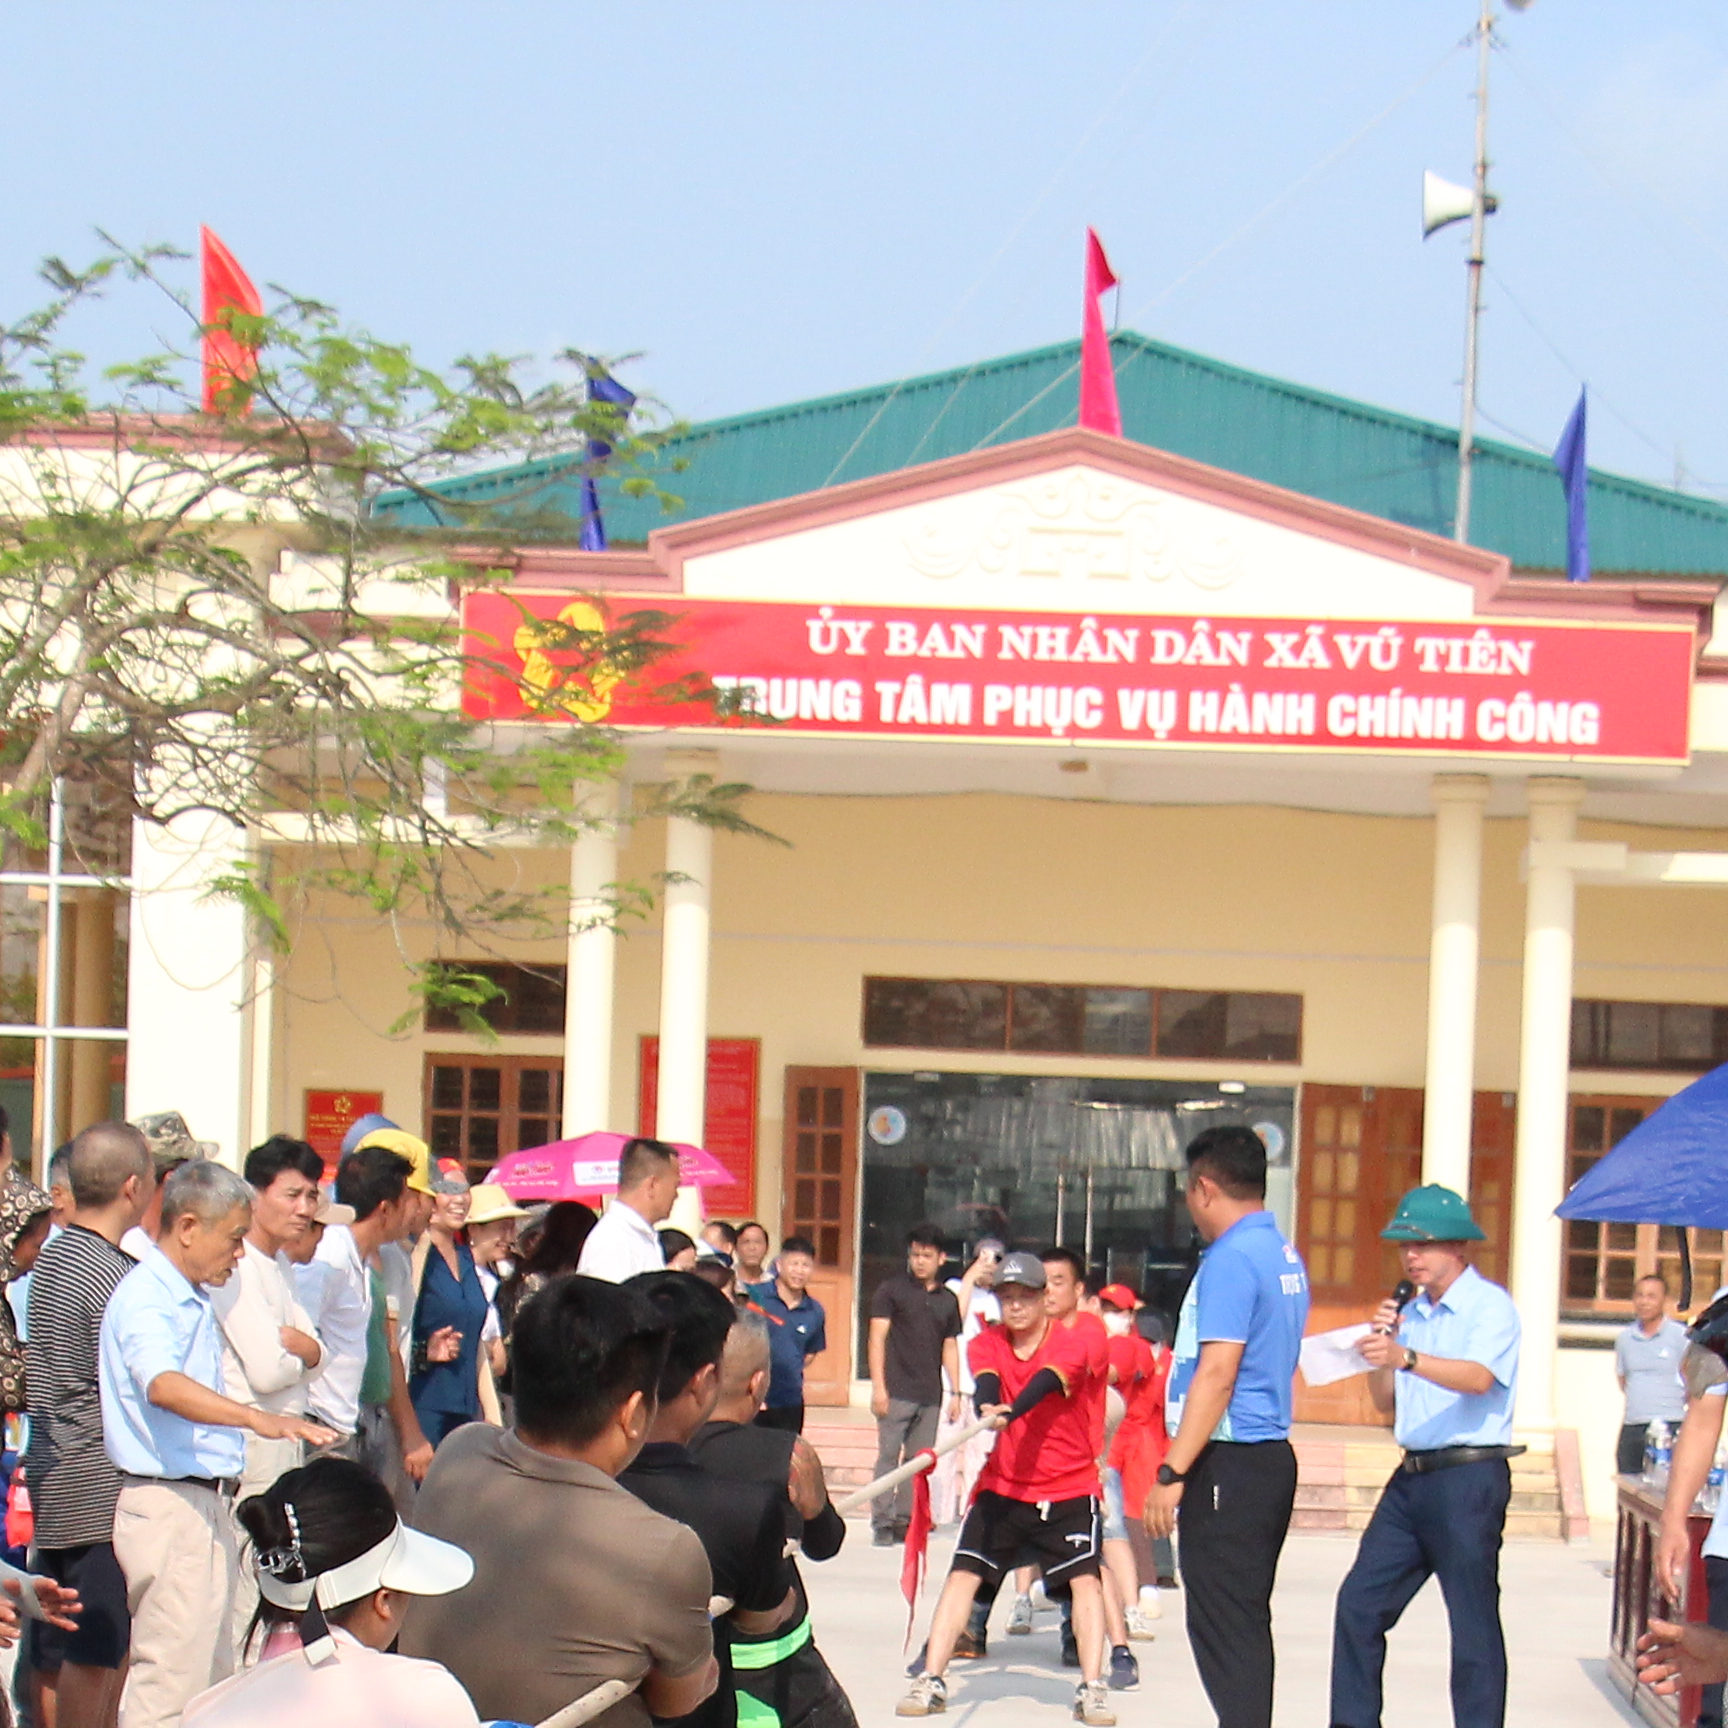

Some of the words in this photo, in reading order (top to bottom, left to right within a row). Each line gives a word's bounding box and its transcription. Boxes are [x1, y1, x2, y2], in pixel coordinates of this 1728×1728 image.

[805, 606, 874, 656] ỦY
[883, 619, 987, 660] BAN
[996, 616, 1141, 665] NHÂN
[1150, 619, 1252, 667] DÂN
[1262, 624, 1331, 669] XÃ
[1332, 625, 1404, 672] VŨ
[1413, 628, 1535, 676] TIÊN
[874, 673, 972, 725] TÂM
[983, 684, 1104, 736] PHỤC
[1116, 689, 1178, 739] VỤ
[1188, 682, 1317, 736] HÀNH
[1326, 686, 1465, 740] CHÍNH
[1475, 691, 1601, 745] CÔNG
